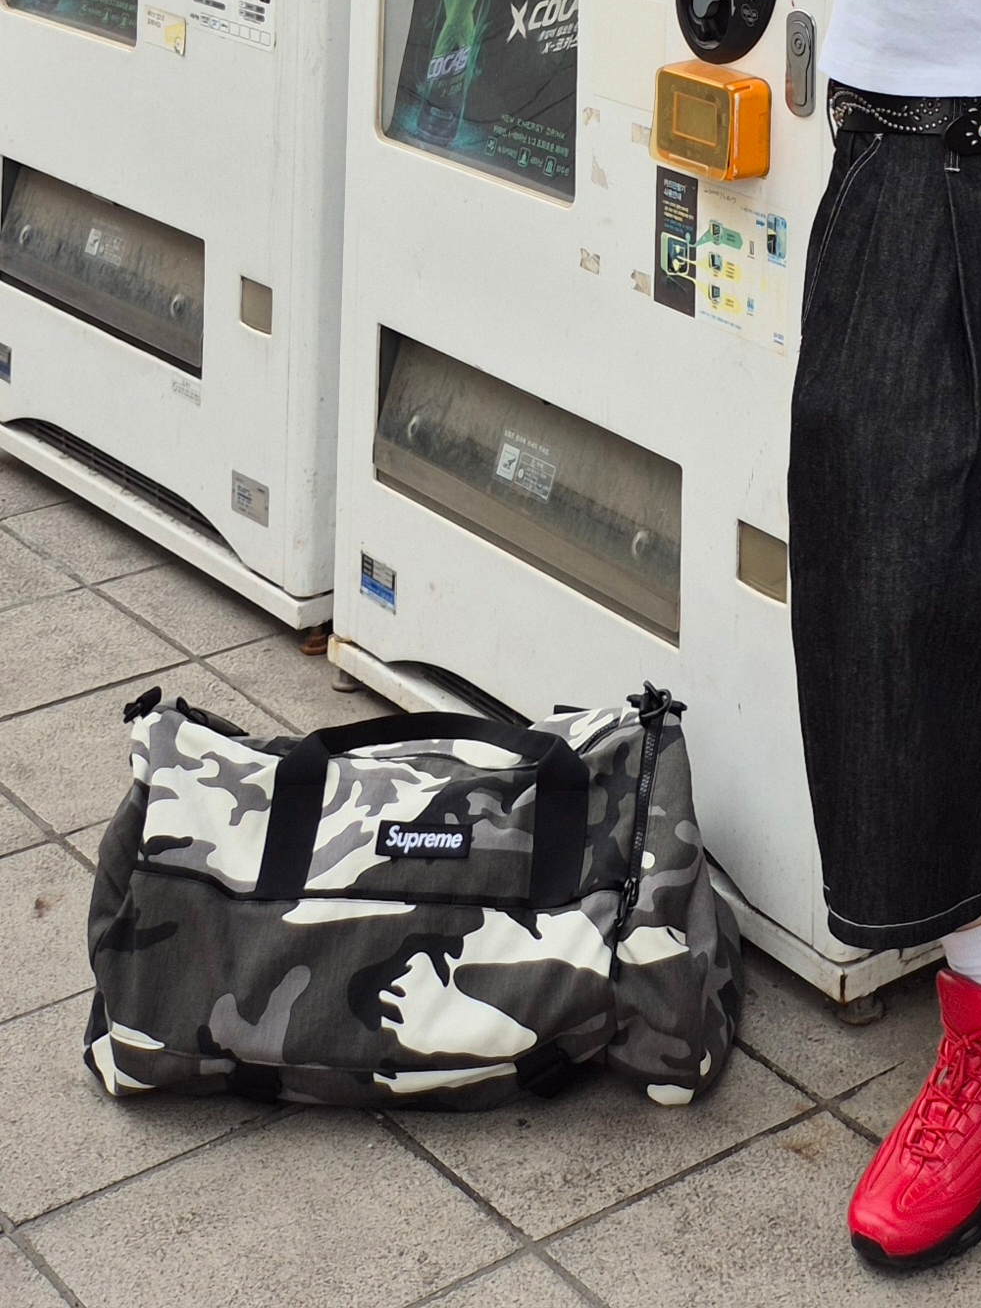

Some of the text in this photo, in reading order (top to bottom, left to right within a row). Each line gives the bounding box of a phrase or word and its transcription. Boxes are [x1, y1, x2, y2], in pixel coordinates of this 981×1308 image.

[501, 113, 567, 140] NEW ENERGY DRINK
[385, 824, 464, 855] Supreme
